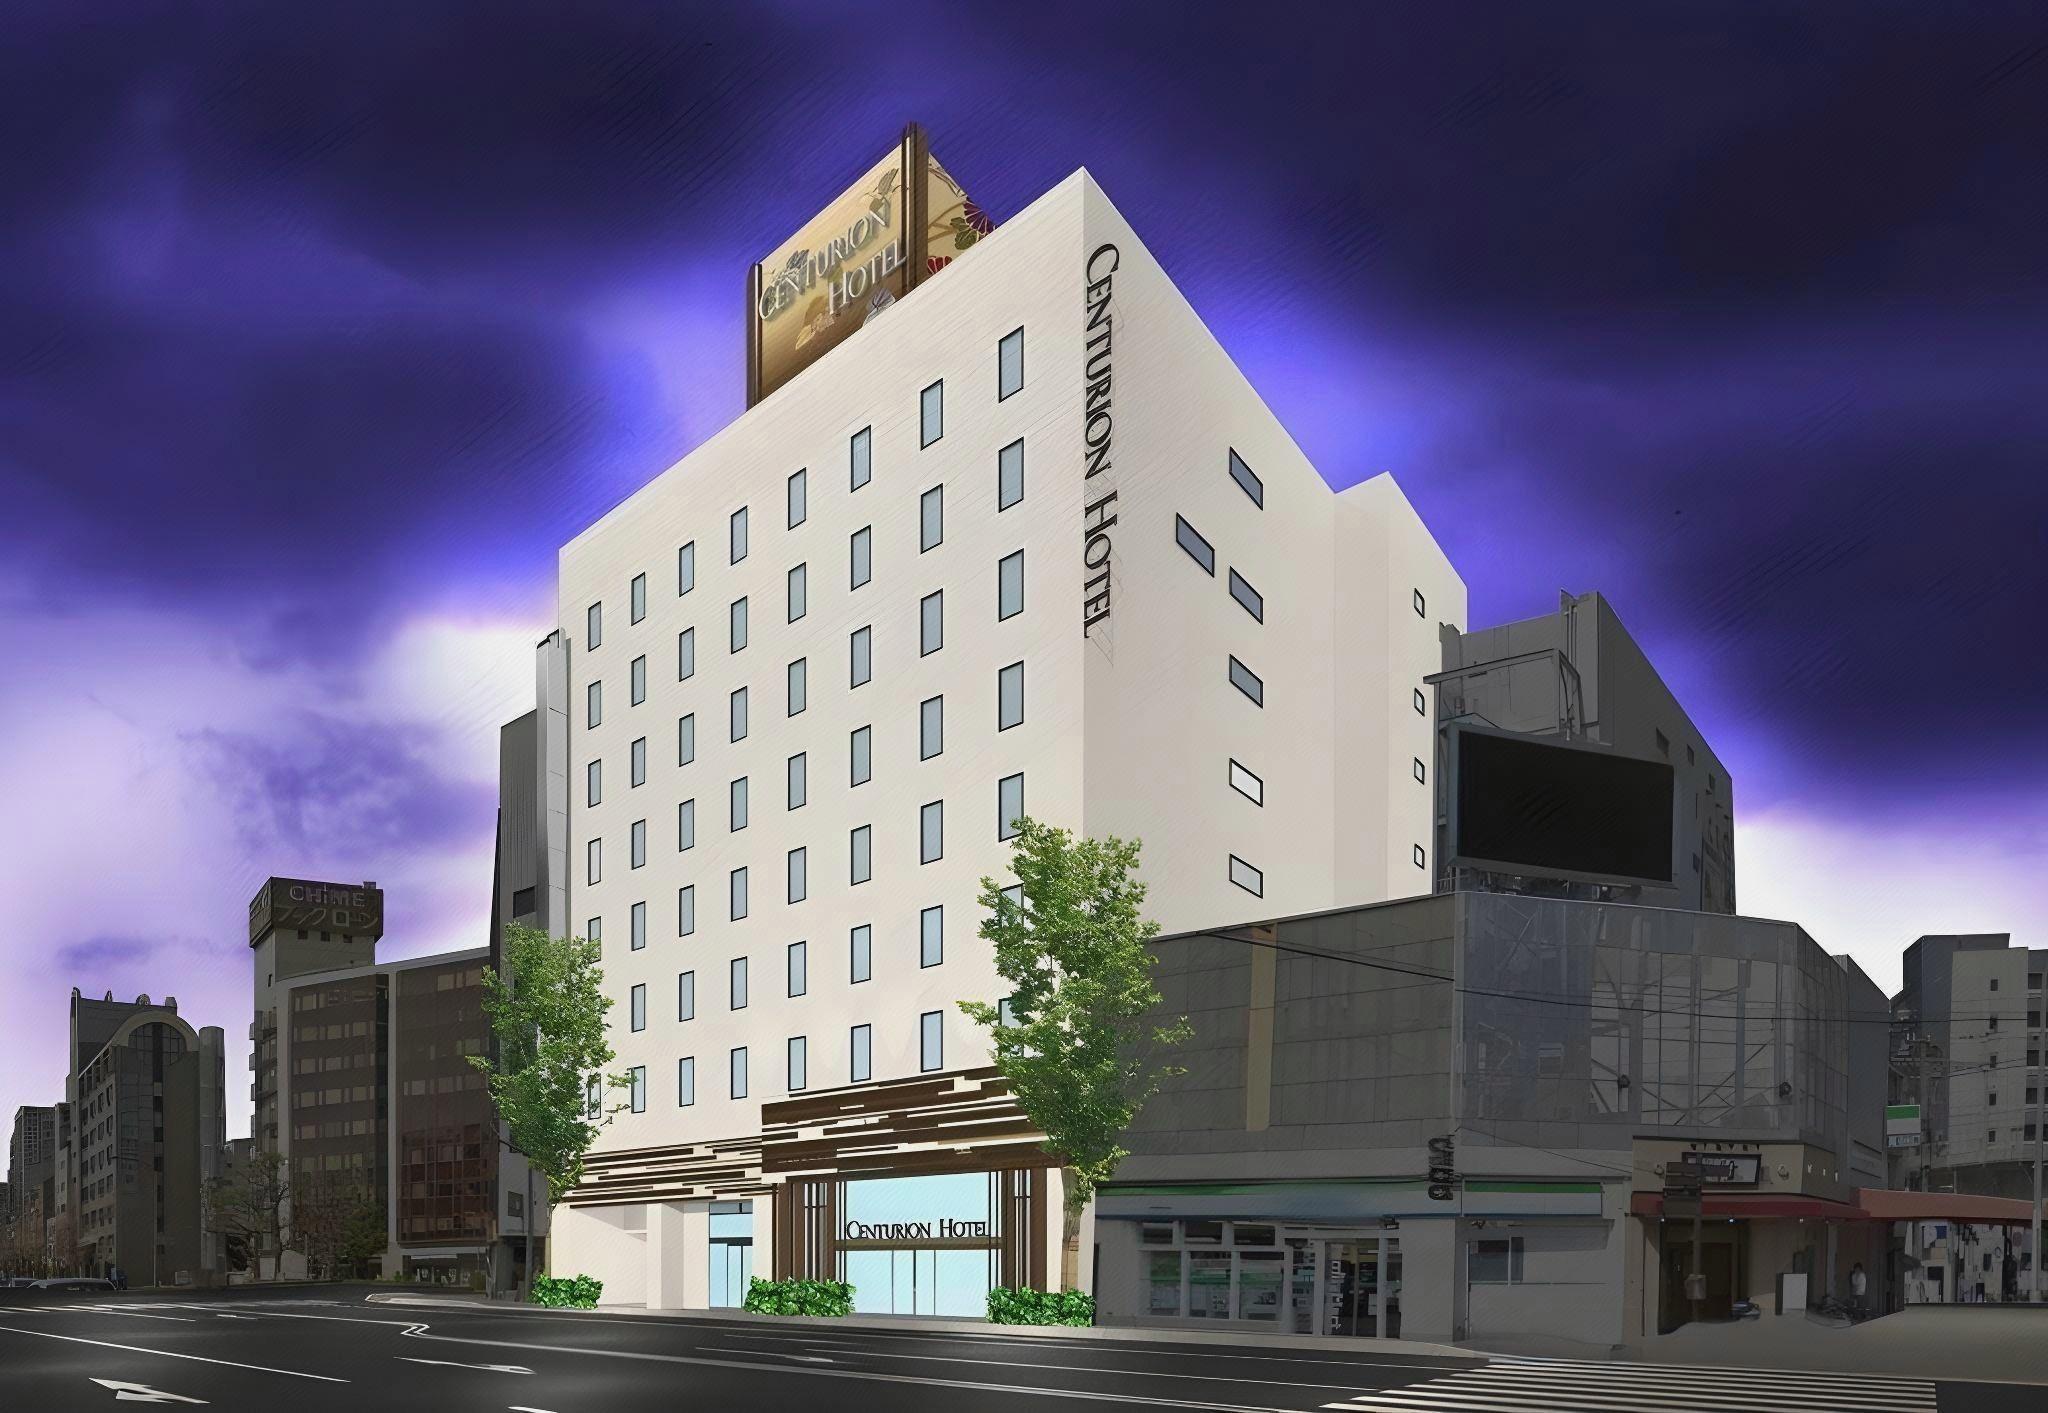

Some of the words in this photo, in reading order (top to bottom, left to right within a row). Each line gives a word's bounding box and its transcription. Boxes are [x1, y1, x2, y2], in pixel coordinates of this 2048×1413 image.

[760, 200, 891, 319] CENTURION
[829, 238, 908, 315] HOTEL
[1085, 243, 1120, 480] CENTURION
[1084, 489, 1118, 639] HOTEL
[846, 1220, 931, 1239] CENTURION
[940, 1218, 989, 1238] HOTEL
